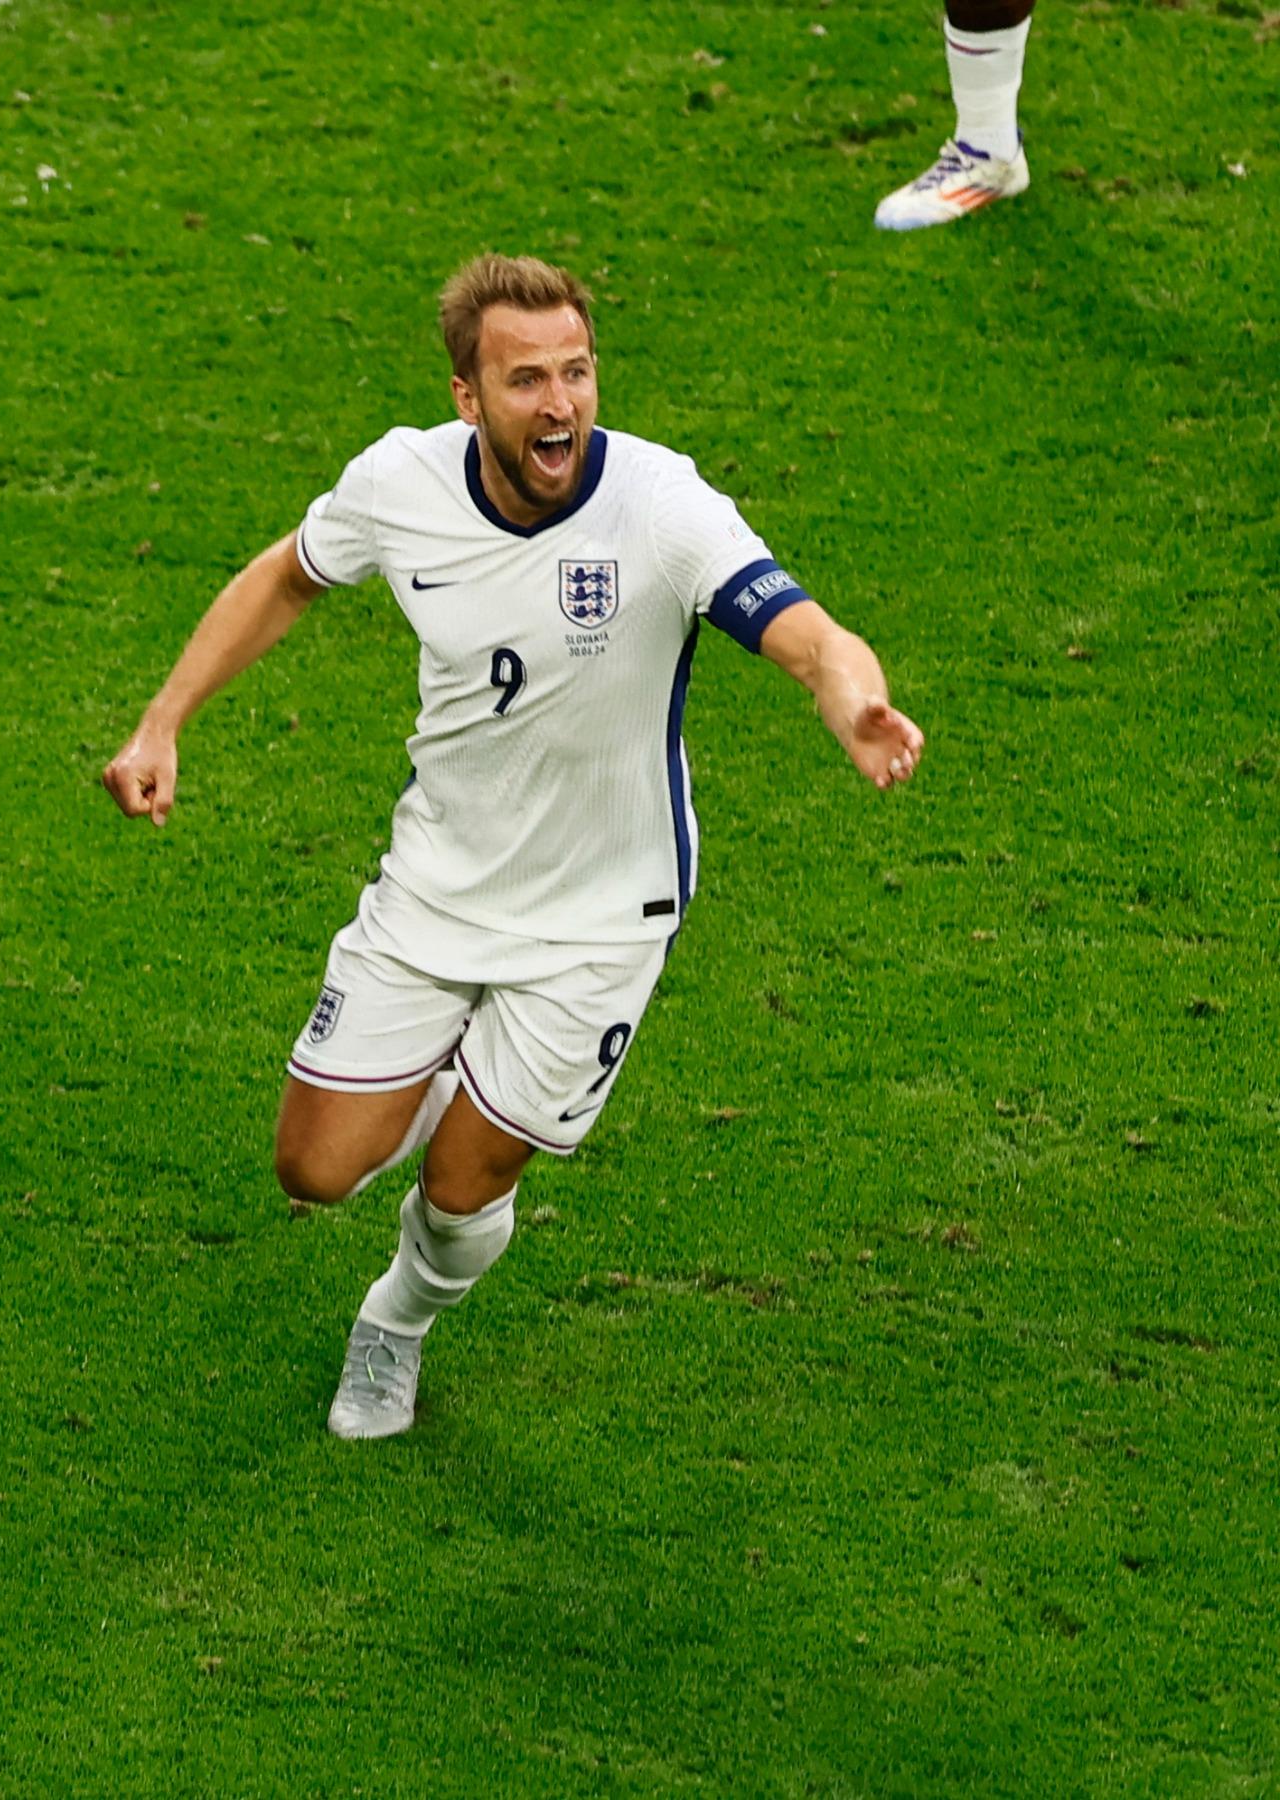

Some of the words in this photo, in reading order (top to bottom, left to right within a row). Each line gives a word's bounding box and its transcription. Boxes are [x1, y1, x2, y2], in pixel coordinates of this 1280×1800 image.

[565, 631, 609, 645] SLOVAKIA
[490, 647, 528, 717] 9
[586, 1022, 632, 1096] 9
